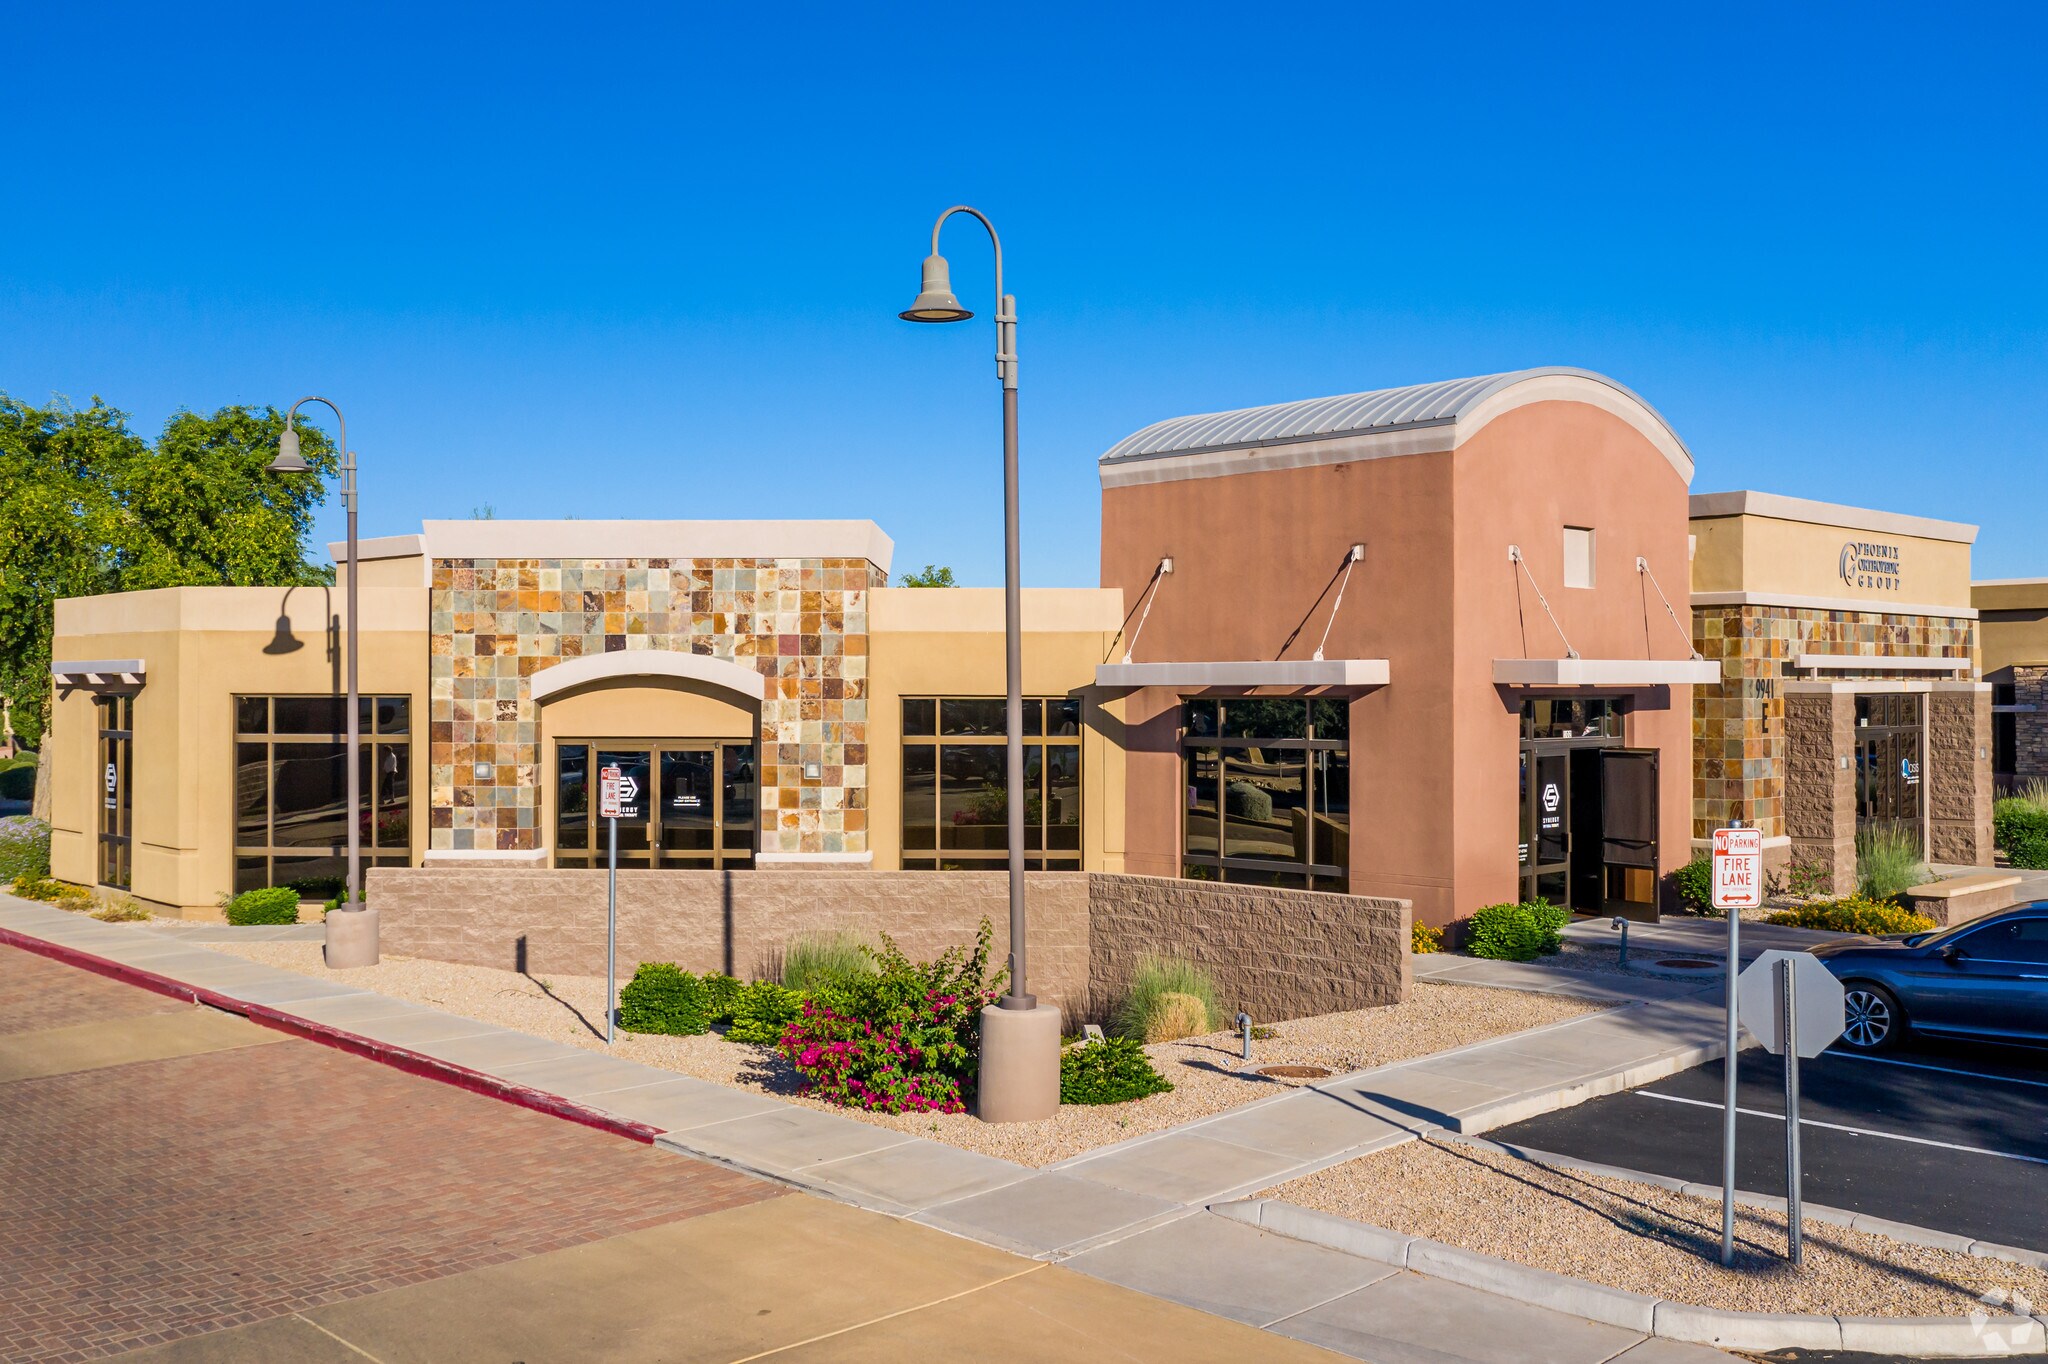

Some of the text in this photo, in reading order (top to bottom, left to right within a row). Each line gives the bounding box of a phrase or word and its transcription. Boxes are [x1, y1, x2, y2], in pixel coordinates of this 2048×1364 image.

[1858, 542, 1898, 559] PHOENIX
[1857, 575, 1900, 591] GROUP
[1755, 678, 1774, 699] 9941
[1762, 703, 1769, 733] E
[607, 782, 615, 790] FIRE
[606, 792, 616, 800] LANE
[1716, 836, 1758, 850] NO PARKING
[1724, 858, 1750, 871] FIRE
[1722, 873, 1751, 885] LANE
